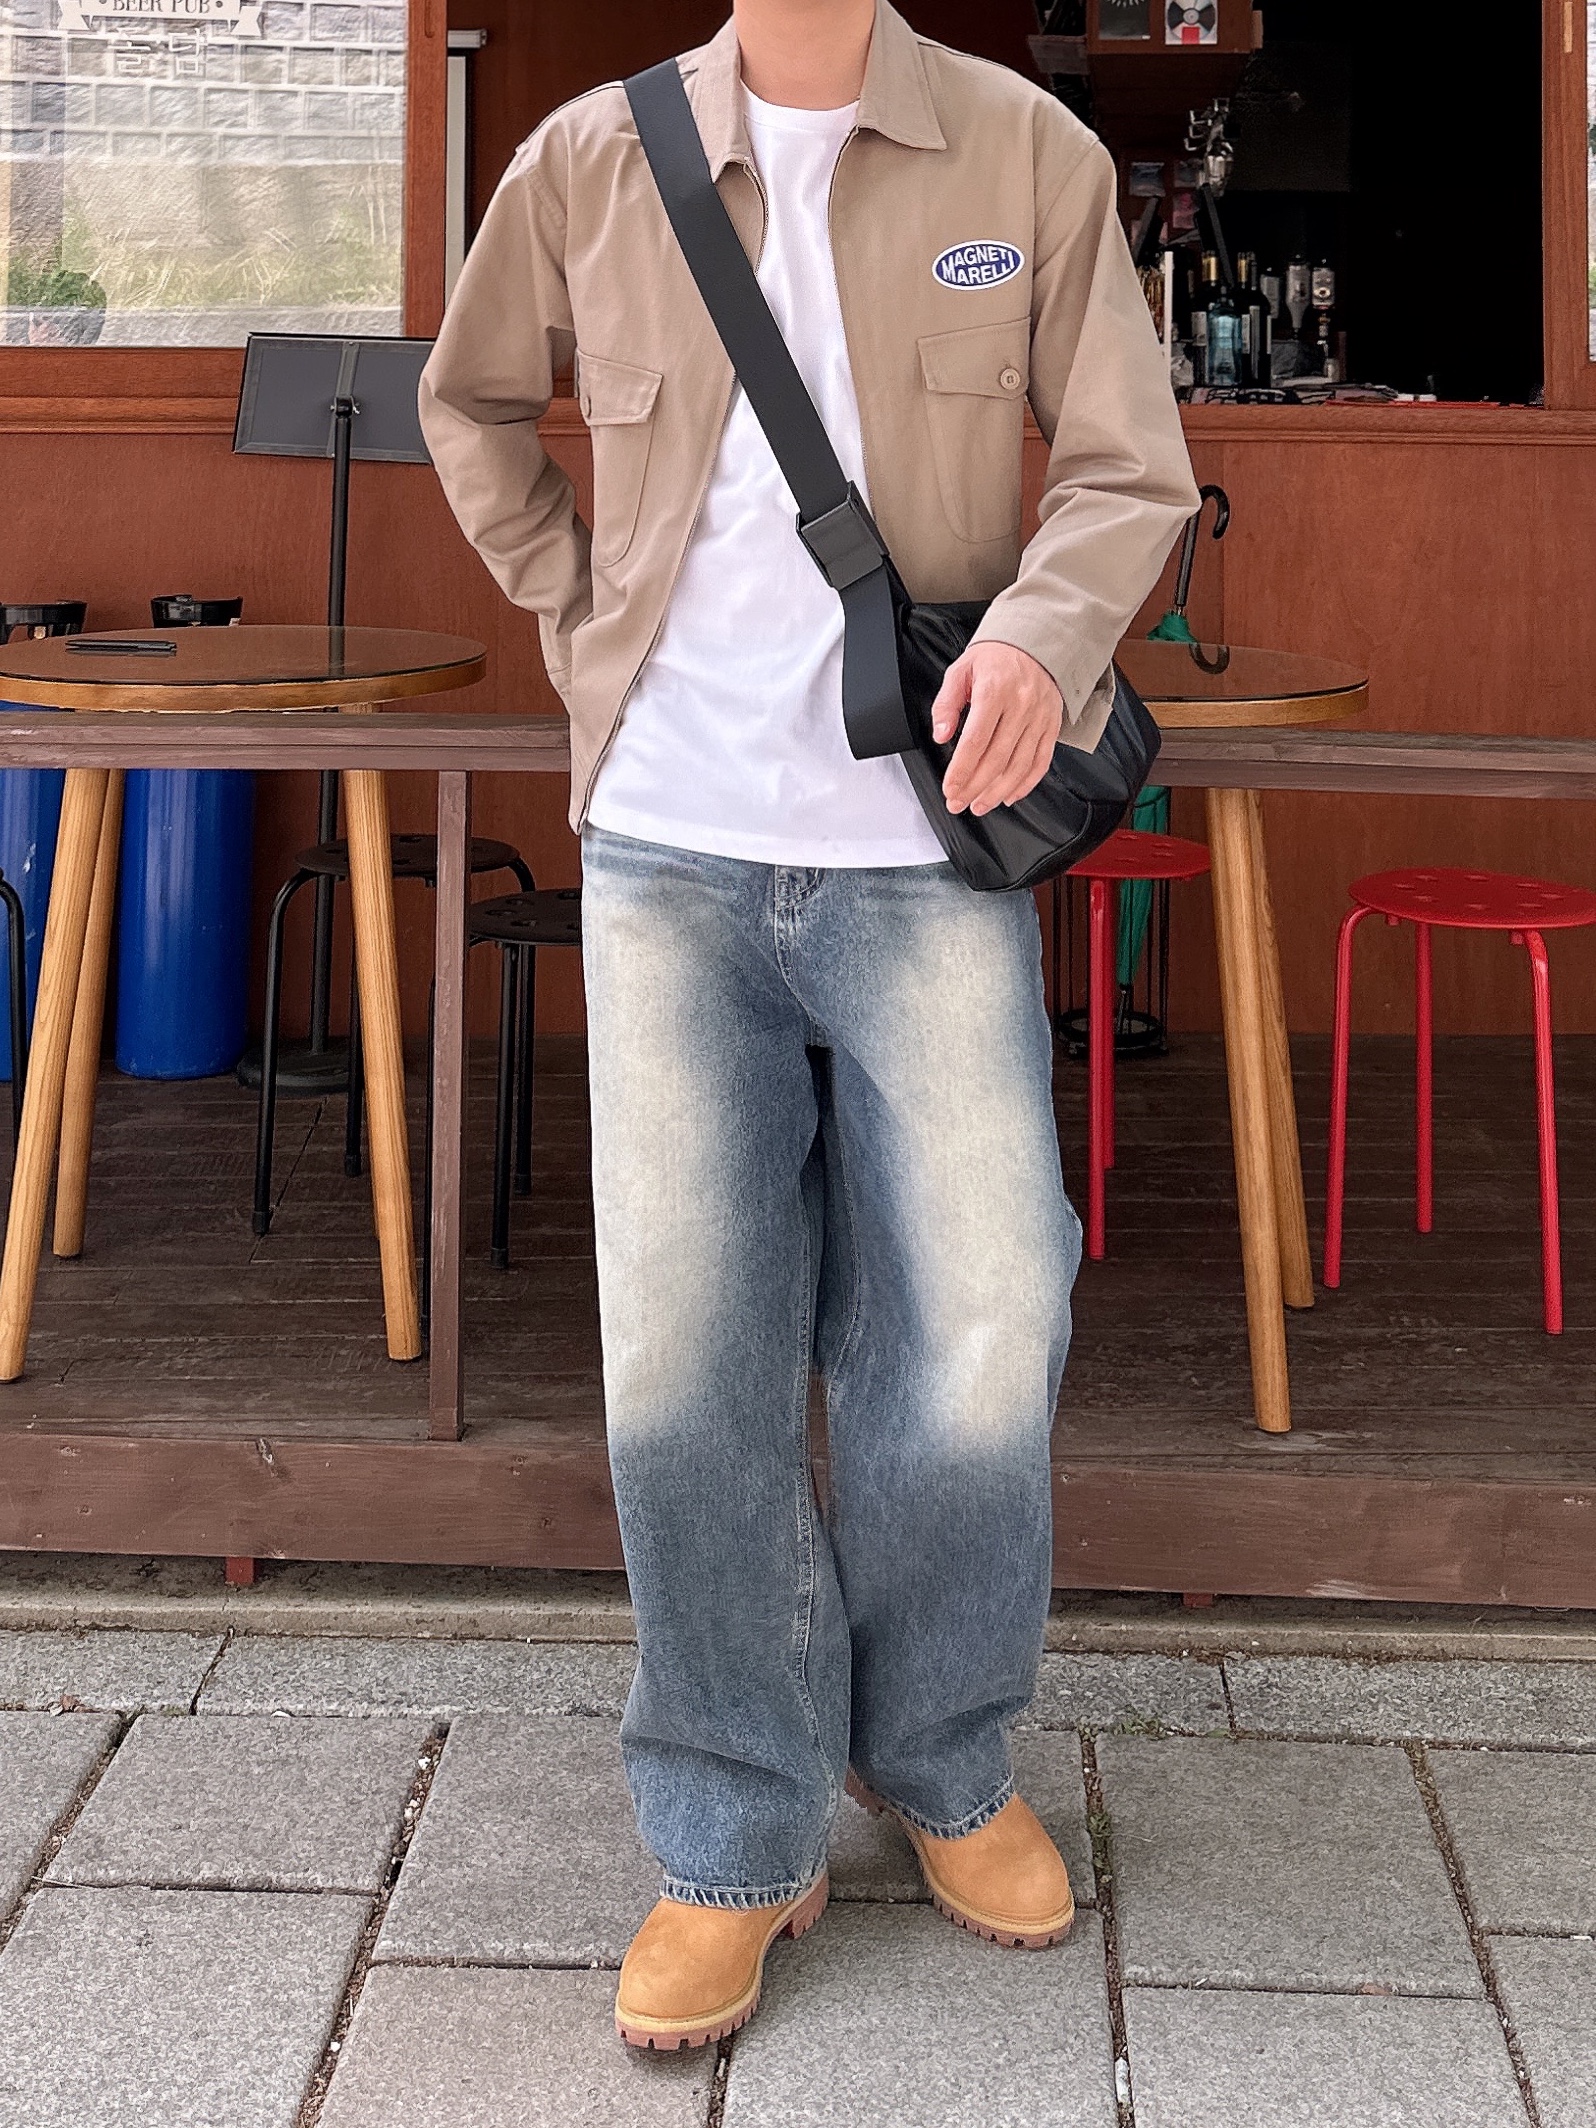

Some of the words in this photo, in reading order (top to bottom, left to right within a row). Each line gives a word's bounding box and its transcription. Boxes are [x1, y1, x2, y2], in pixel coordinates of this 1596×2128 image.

[112, 0, 163, 13] BEER
[171, 0, 211, 14] PUB
[941, 246, 1015, 271] MAGNETI
